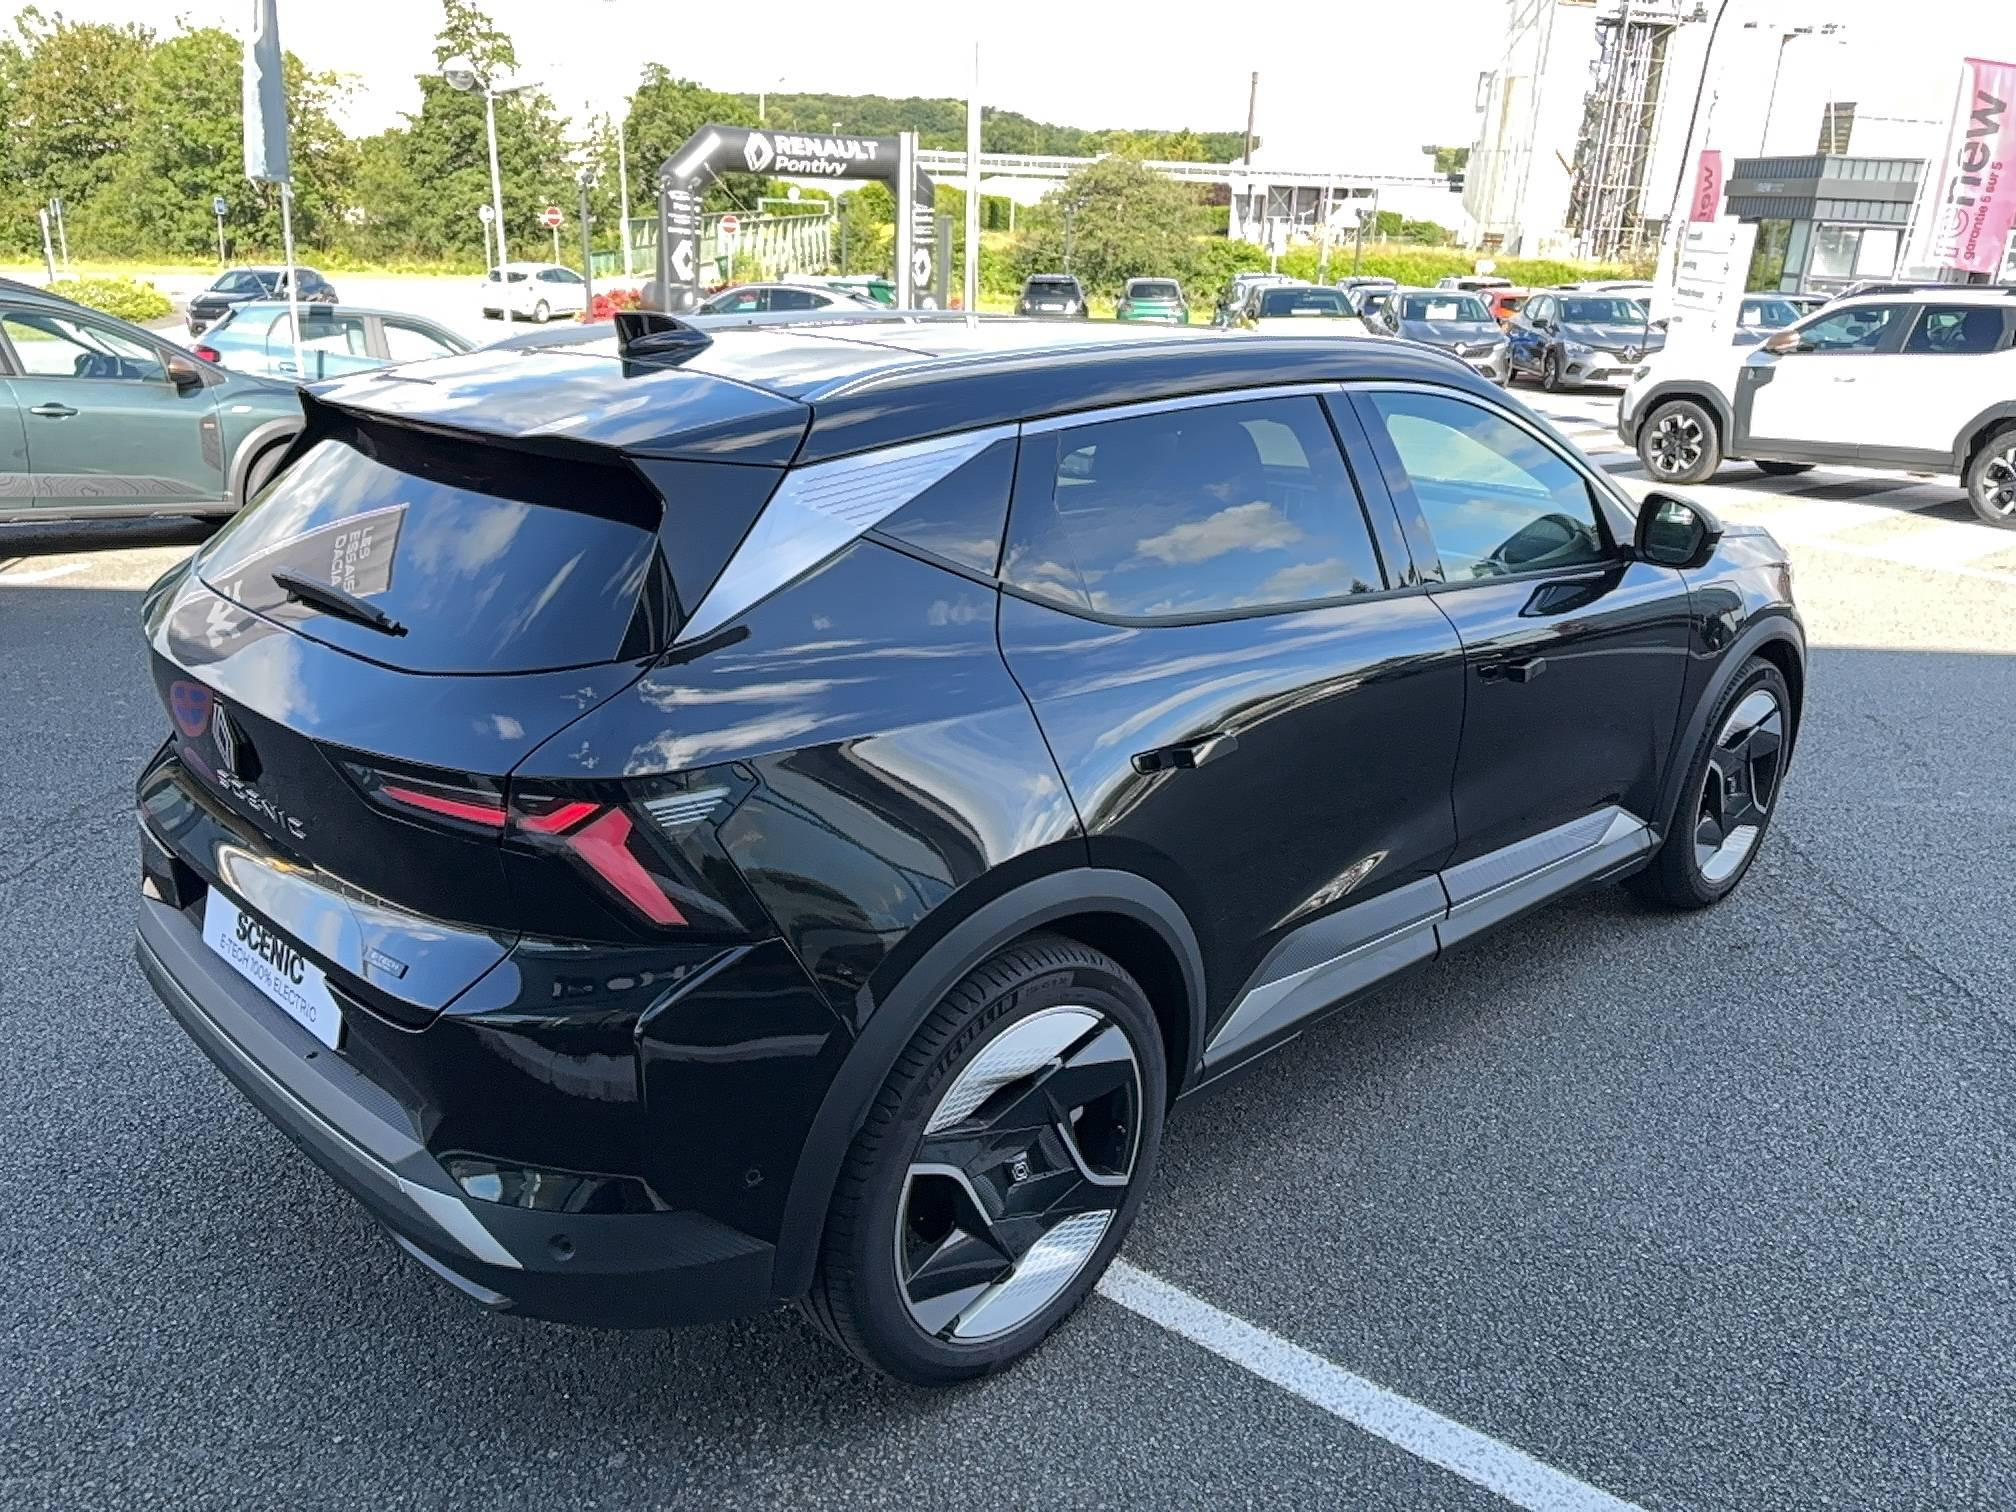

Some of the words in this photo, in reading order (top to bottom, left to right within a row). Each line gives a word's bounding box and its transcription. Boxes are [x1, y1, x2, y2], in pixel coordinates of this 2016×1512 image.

[774, 135, 878, 160] RENAULT
[775, 156, 847, 176] Pontivy
[1992, 161, 2003, 171] 5
[1934, 90, 2007, 258] renew
[1986, 173, 1999, 194] sur
[1964, 205, 1988, 260] garantie
[331, 534, 348, 587] DACIA
[343, 530, 361, 593] ESSAIS
[360, 526, 375, 559] LES
[217, 769, 307, 839] SCENIC
[236, 912, 304, 985] SCENIC
[273, 976, 318, 1023] ELECTRIC
